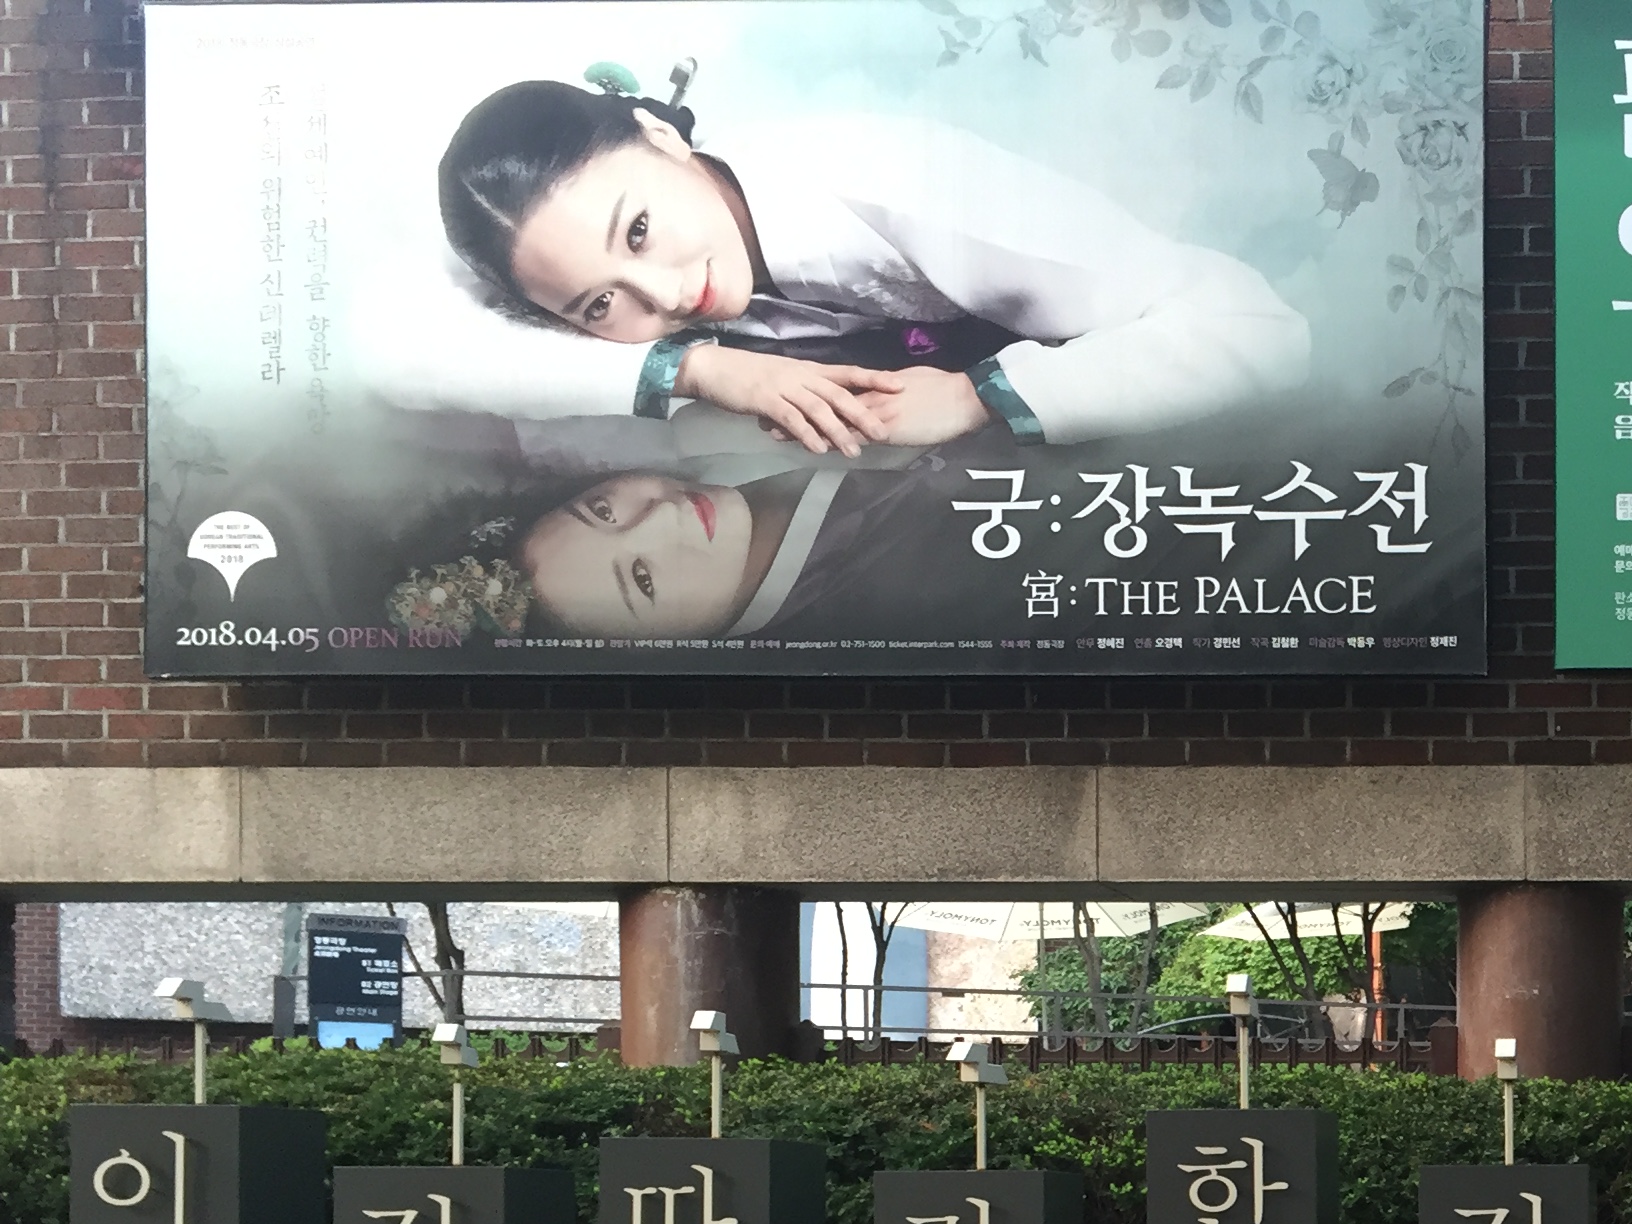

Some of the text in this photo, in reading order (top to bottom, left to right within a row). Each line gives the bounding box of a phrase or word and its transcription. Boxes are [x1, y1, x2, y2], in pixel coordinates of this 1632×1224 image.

[259, 176, 286, 262] 위험한
[259, 270, 286, 385] 신데렐라
[304, 314, 332, 372] 향한
[1195, 575, 1378, 616] PALACE
[176, 620, 463, 652] 2018.04.05 OPEN RUN
[317, 917, 400, 931] INFORMATION
